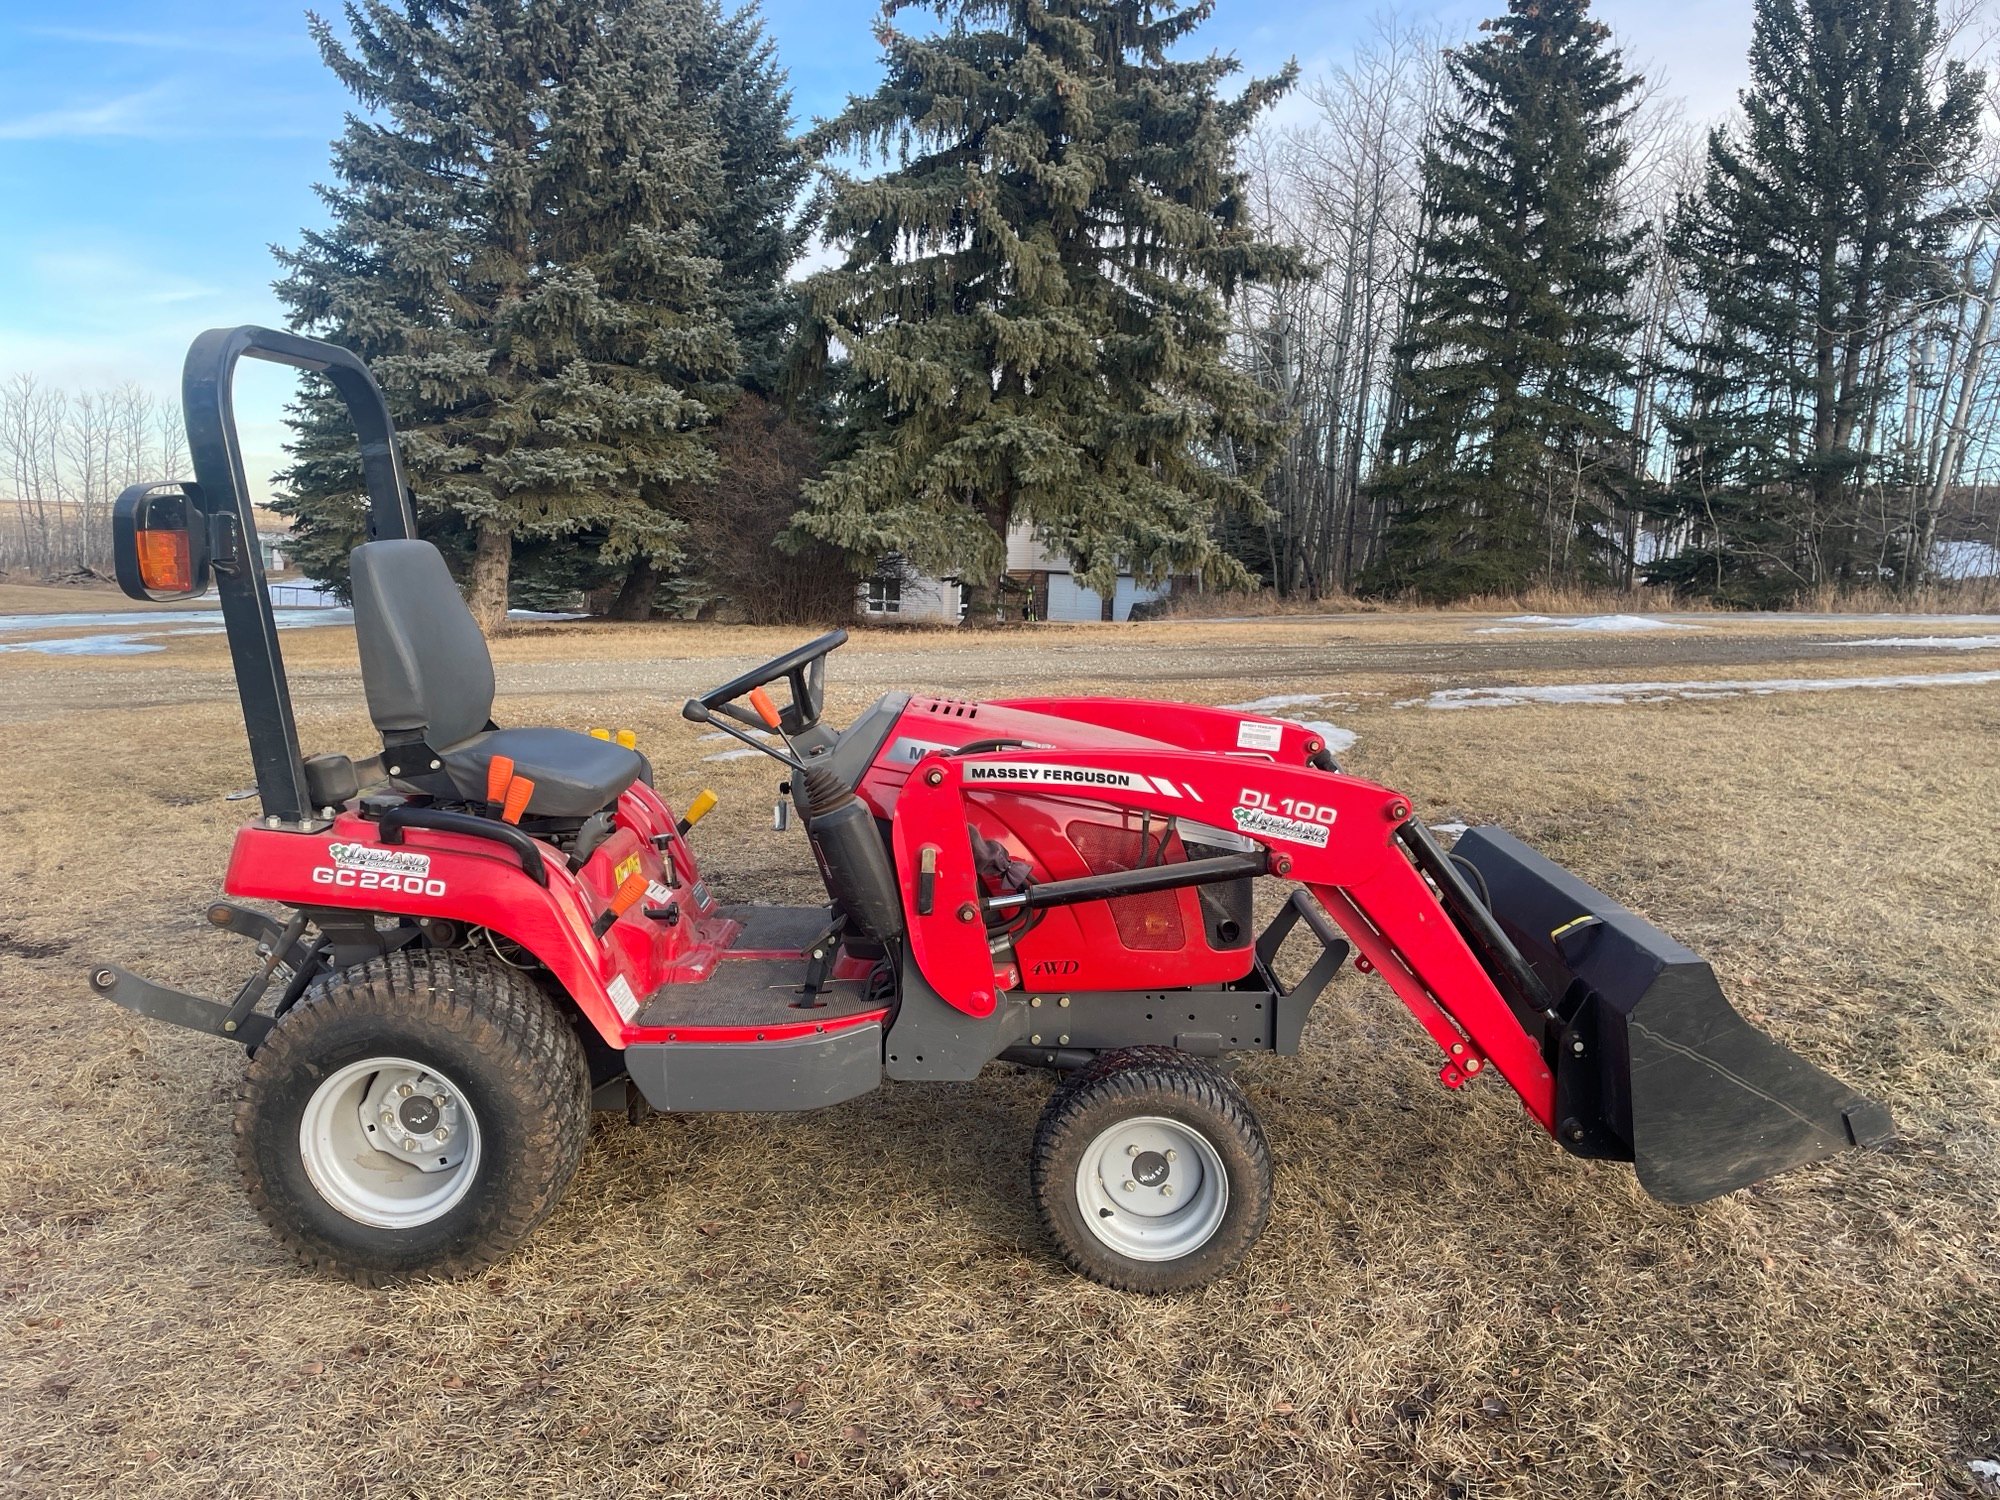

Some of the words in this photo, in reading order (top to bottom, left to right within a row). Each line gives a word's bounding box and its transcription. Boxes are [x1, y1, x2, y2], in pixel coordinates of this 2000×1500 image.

[971, 768, 1039, 779] MASSEY
[1043, 769, 1130, 786] FERGUSON
[1239, 788, 1338, 825] DL100
[347, 845, 429, 866] IRELAND
[312, 867, 447, 897] GC2400
[1030, 960, 1080, 975] 4WD
